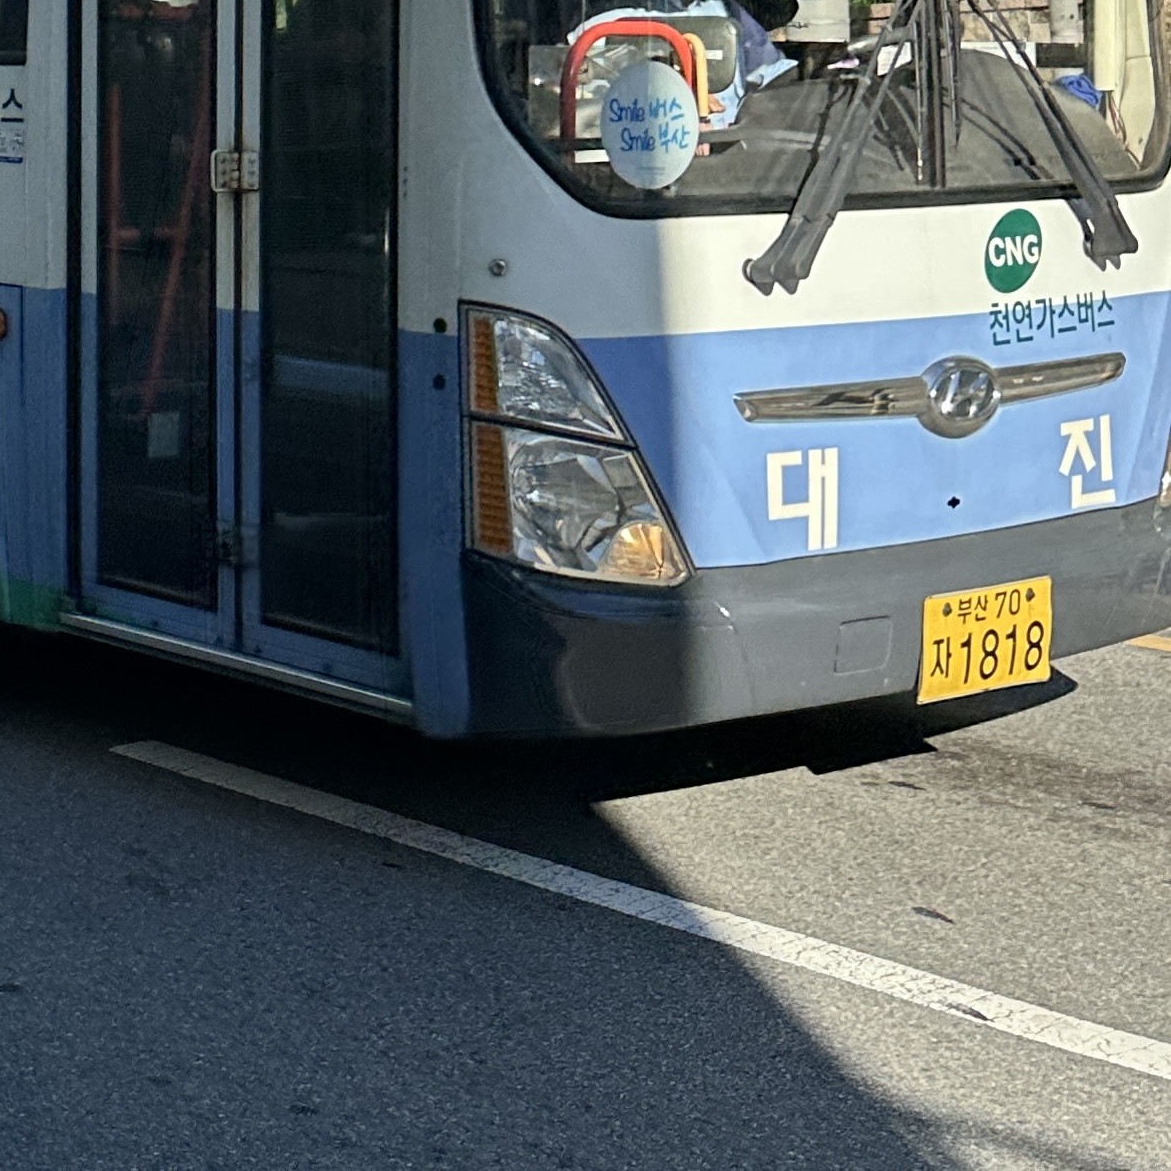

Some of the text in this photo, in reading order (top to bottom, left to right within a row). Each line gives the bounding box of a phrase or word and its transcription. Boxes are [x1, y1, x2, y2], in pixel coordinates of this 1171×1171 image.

[609, 98, 684, 122] Smile 버스
[620, 122, 690, 153] Smile 부산
[988, 234, 1040, 267] CNG
[989, 290, 1115, 346] 천연가스버스
